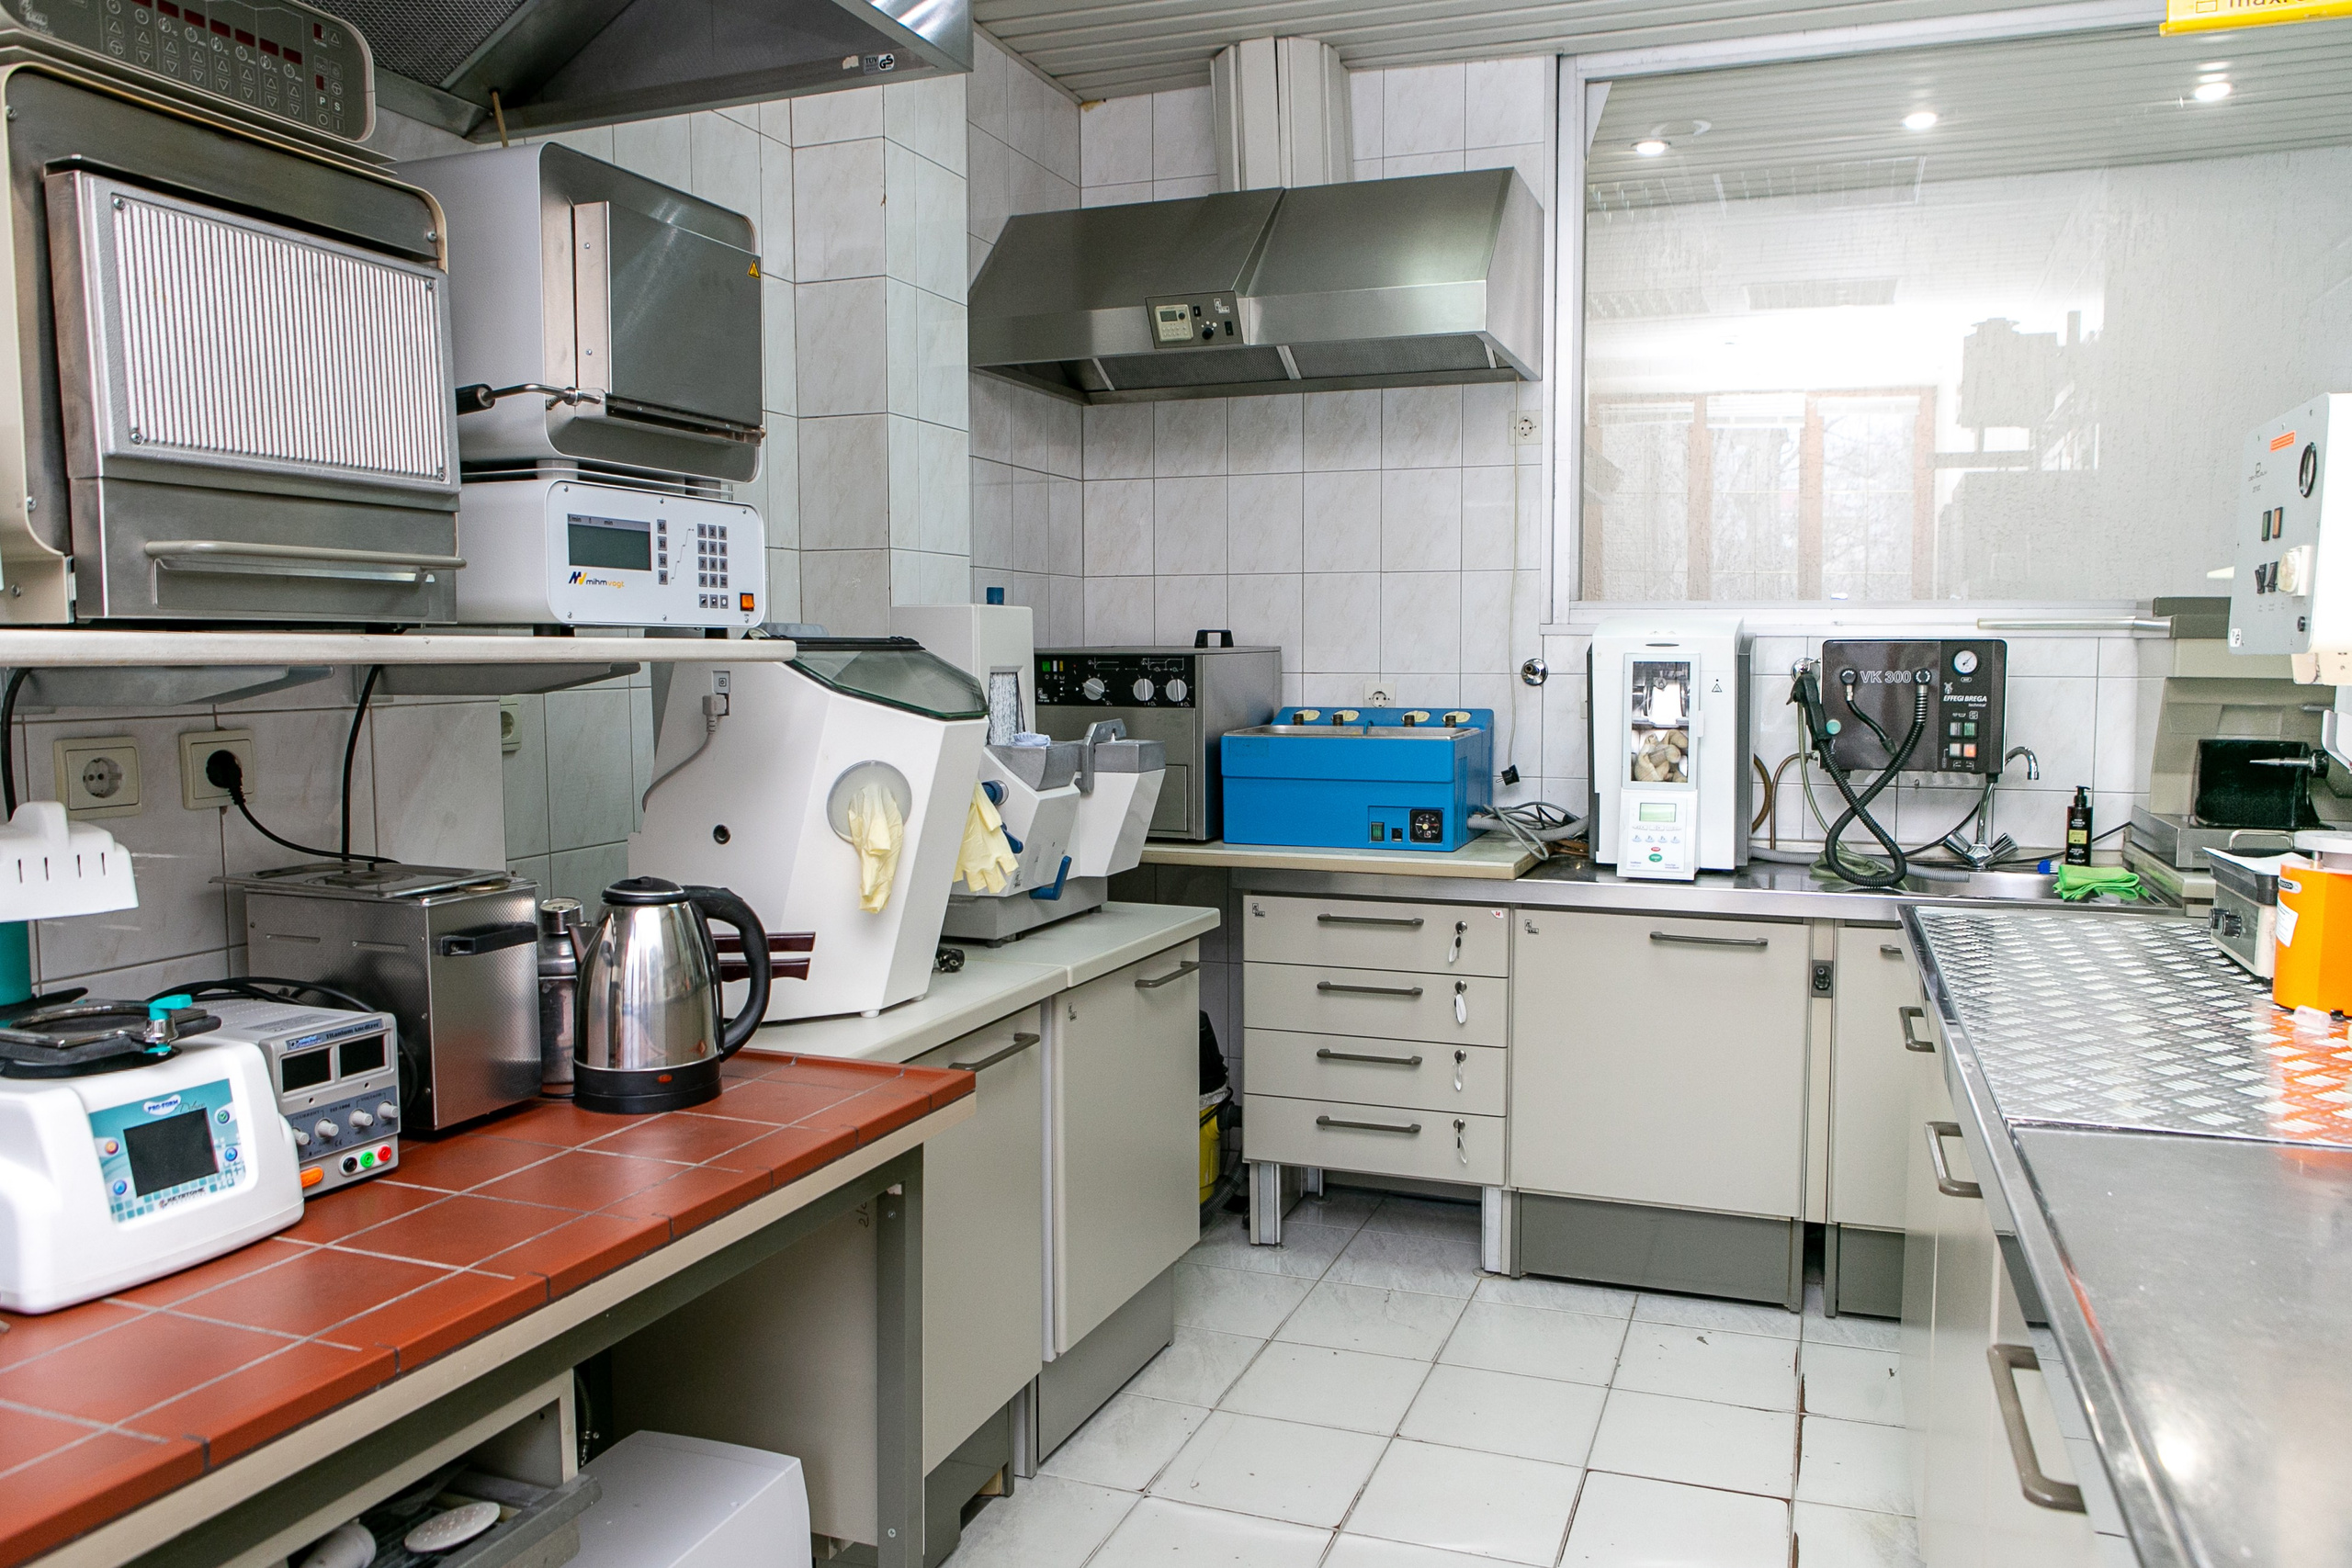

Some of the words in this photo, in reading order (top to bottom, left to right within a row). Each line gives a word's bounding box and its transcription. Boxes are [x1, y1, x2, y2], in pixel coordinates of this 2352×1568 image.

[319, 96, 326, 105] P
[334, 102, 341, 111] S
[1860, 671, 1883, 683] VK
[1884, 671, 1912, 683] 300
[1964, 694, 1987, 703] BREGA
[325, 1029, 354, 1040] Titanium
